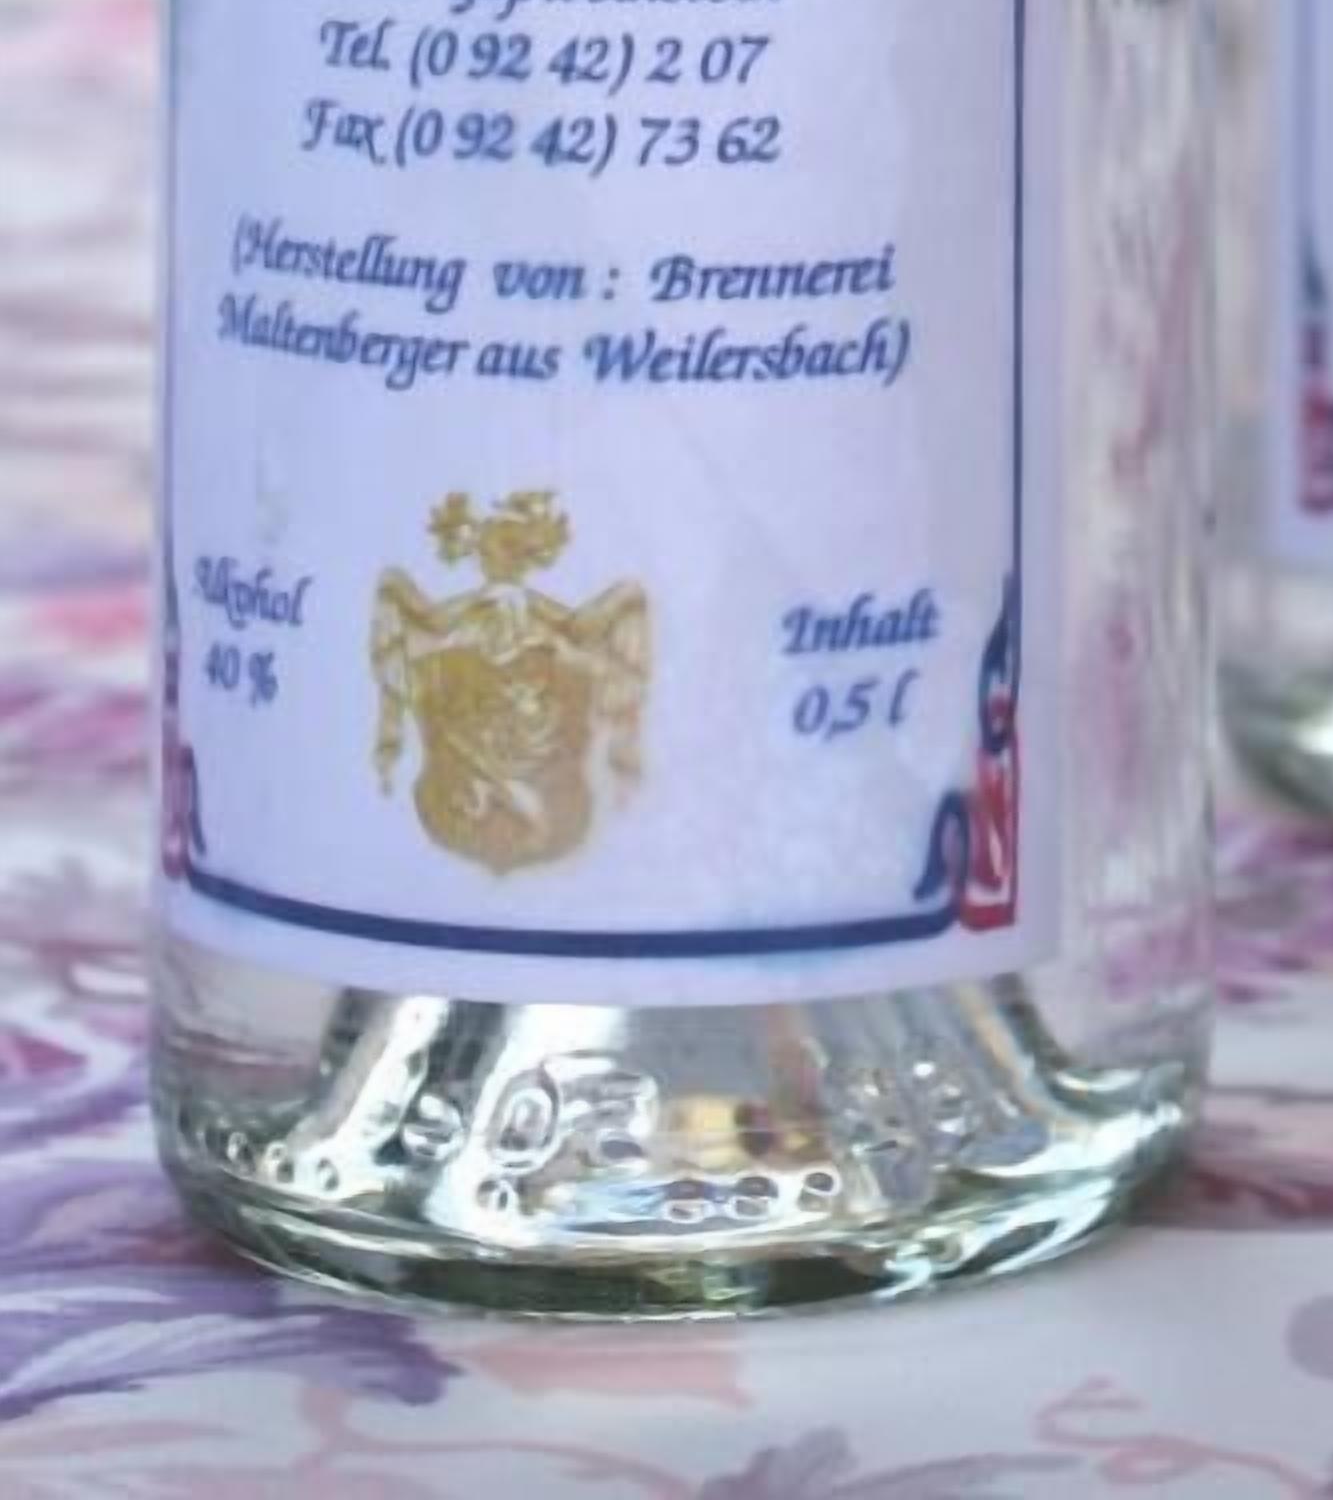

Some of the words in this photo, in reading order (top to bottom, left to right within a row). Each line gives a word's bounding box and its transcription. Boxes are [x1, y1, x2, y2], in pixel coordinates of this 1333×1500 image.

[465, 37, 532, 83] 92
[646, 39, 685, 83] 2
[700, 34, 773, 85] 07
[301, 98, 386, 166] Fax
[452, 111, 516, 161] 92
[635, 117, 702, 166] 73
[716, 115, 783, 164] 62
[491, 255, 587, 300] von
[648, 245, 895, 301] Brennerei
[475, 340, 559, 382] aus
[580, 319, 912, 389] Weilersbach)
[779, 588, 941, 656] Inhalt
